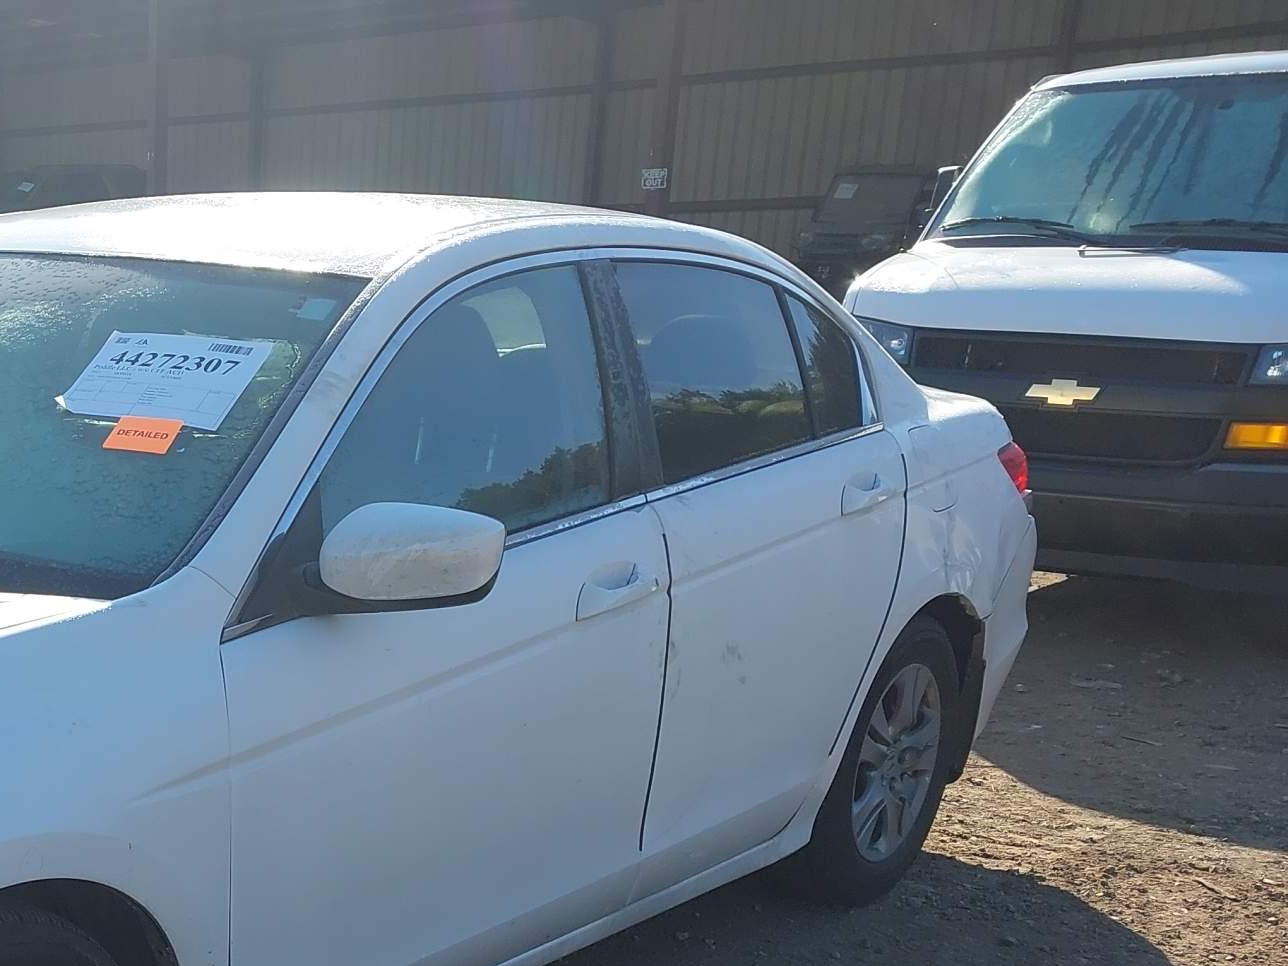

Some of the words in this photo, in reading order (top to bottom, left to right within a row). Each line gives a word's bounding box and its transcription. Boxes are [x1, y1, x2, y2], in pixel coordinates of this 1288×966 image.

[644, 178, 664, 187] OUT
[109, 350, 241, 375] 44272307
[116, 428, 169, 440] DETAILED
